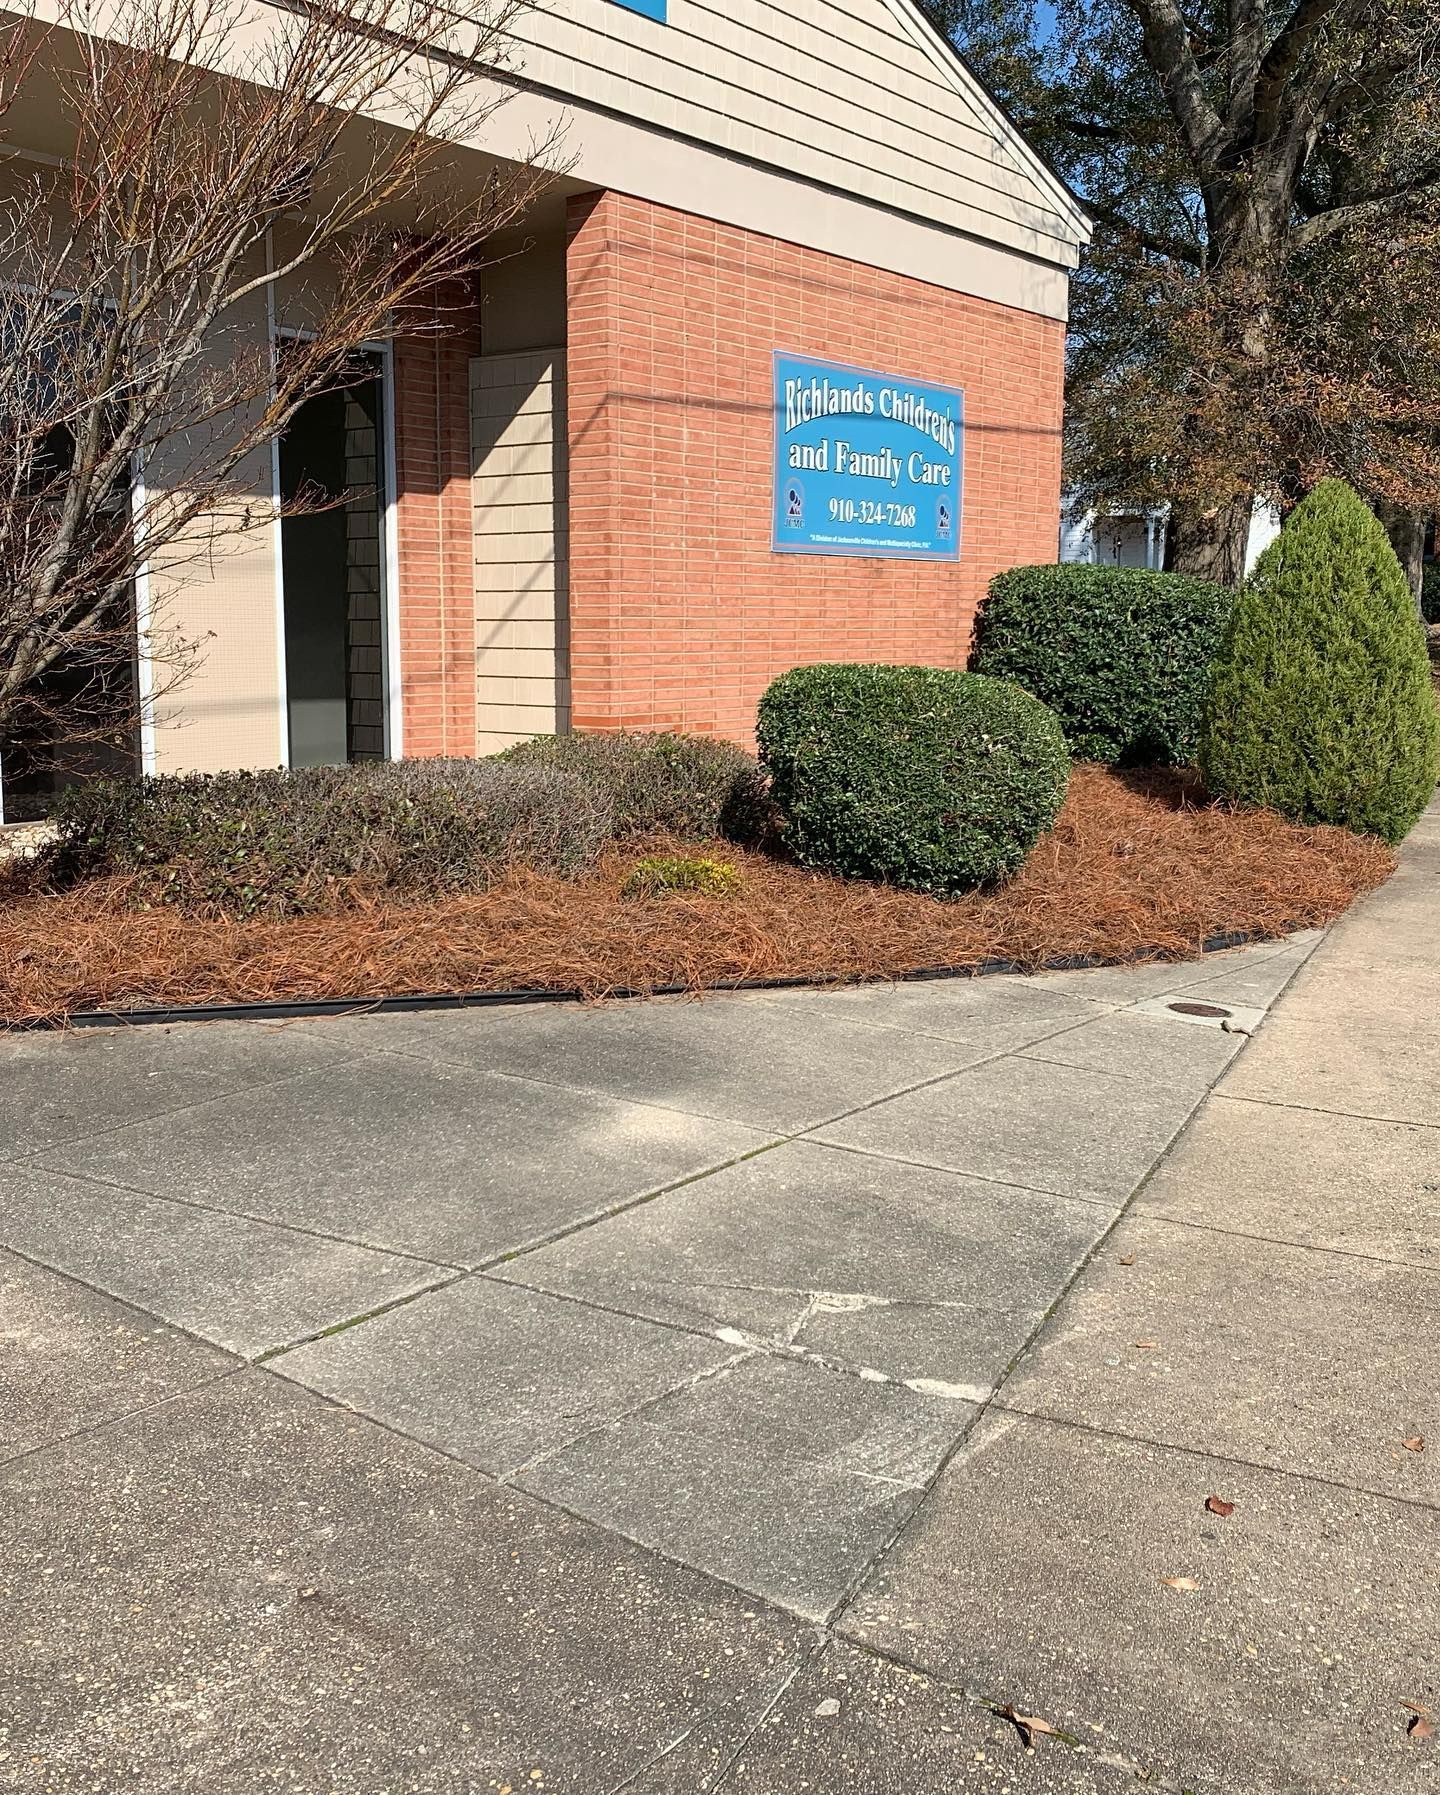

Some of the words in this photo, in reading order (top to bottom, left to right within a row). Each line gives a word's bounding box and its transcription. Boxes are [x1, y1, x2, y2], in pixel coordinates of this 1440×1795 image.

[785, 376, 873, 433] Richlands
[879, 388, 956, 456] Children's
[789, 438, 829, 471] and
[834, 442, 902, 488] Family
[908, 452, 951, 486] Care
[829, 497, 916, 527] 910-324-7268
